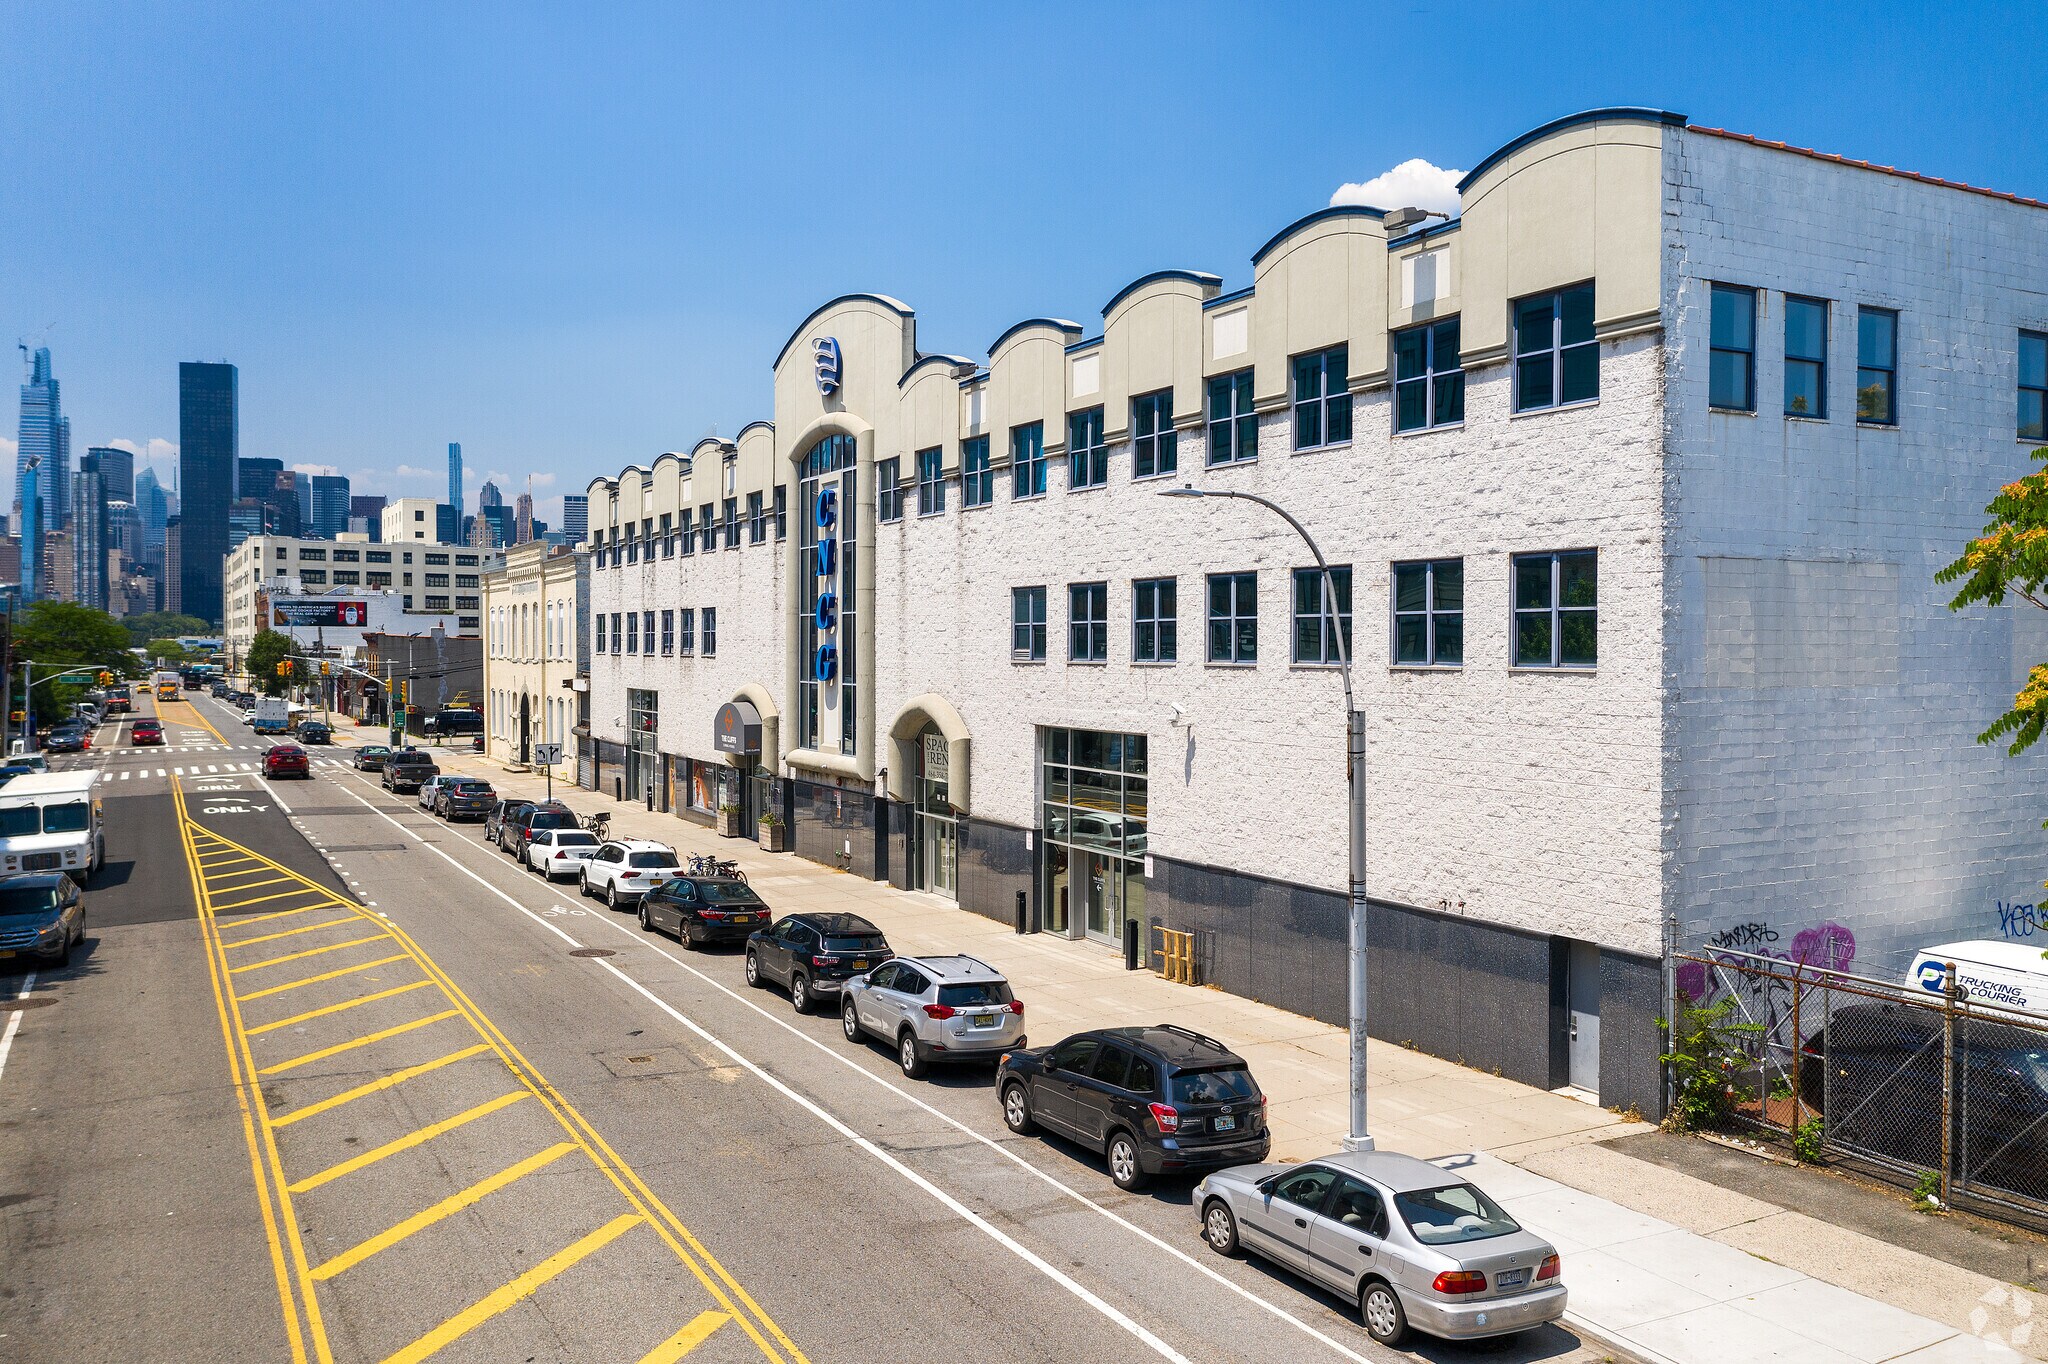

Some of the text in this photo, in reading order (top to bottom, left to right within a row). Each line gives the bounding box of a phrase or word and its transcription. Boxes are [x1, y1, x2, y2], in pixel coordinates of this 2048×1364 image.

[203, 805, 269, 814] ONLY
[1959, 975, 2023, 996] TRUCKING
[1970, 987, 2028, 1007] COURIER
